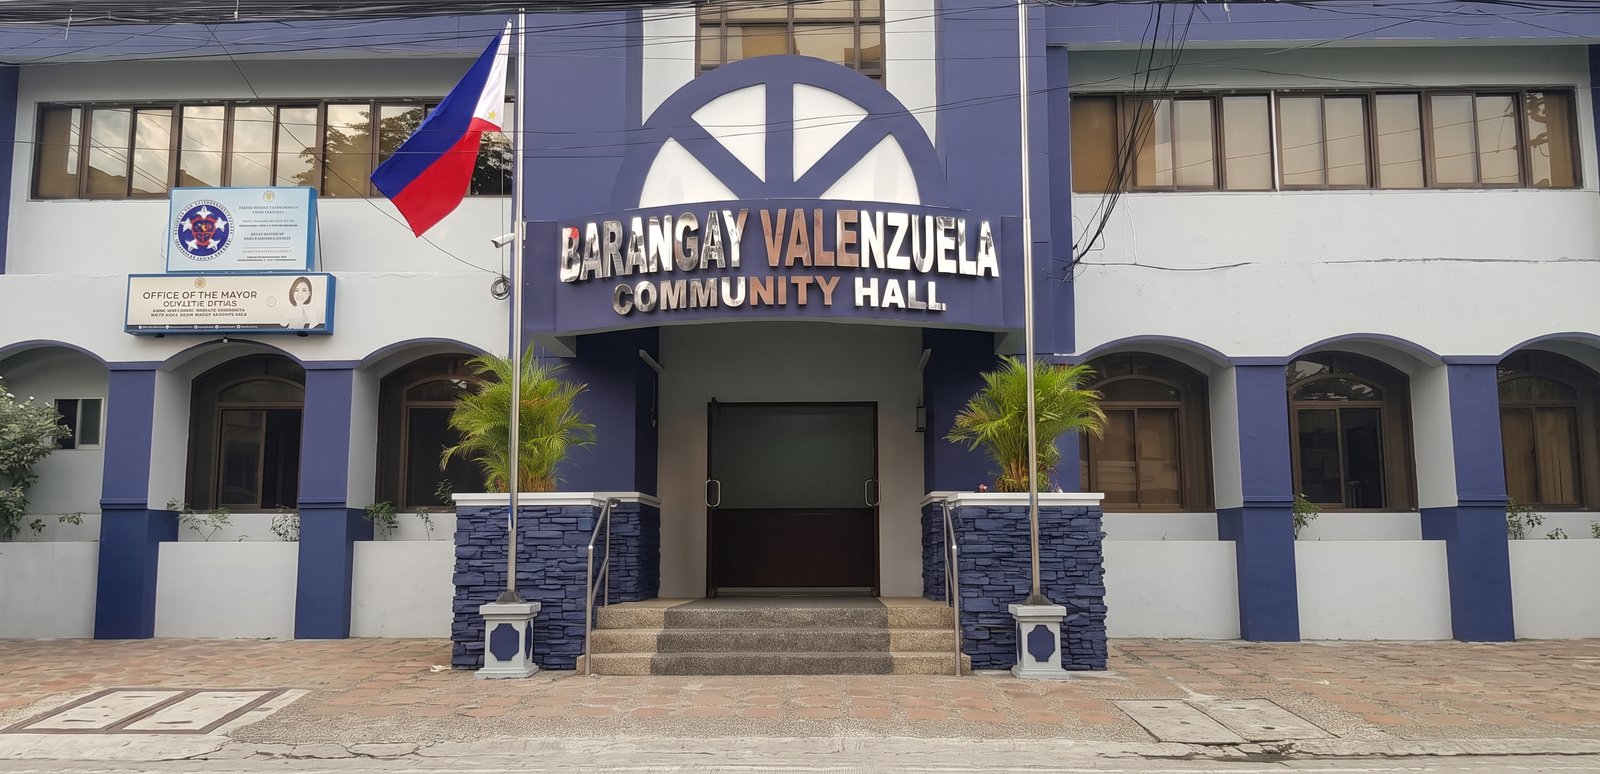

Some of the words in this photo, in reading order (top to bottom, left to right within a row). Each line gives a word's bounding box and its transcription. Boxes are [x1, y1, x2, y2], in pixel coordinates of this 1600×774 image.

[559, 208, 748, 284] BARANGAY
[760, 207, 1000, 279] VALENZUELA
[142, 291, 180, 299] OFFICE
[182, 291, 196, 299] OF
[198, 291, 218, 299] THE
[221, 290, 258, 299] MAYOR
[612, 276, 840, 315] COMMUNITY
[854, 276, 947, 312] HALL
